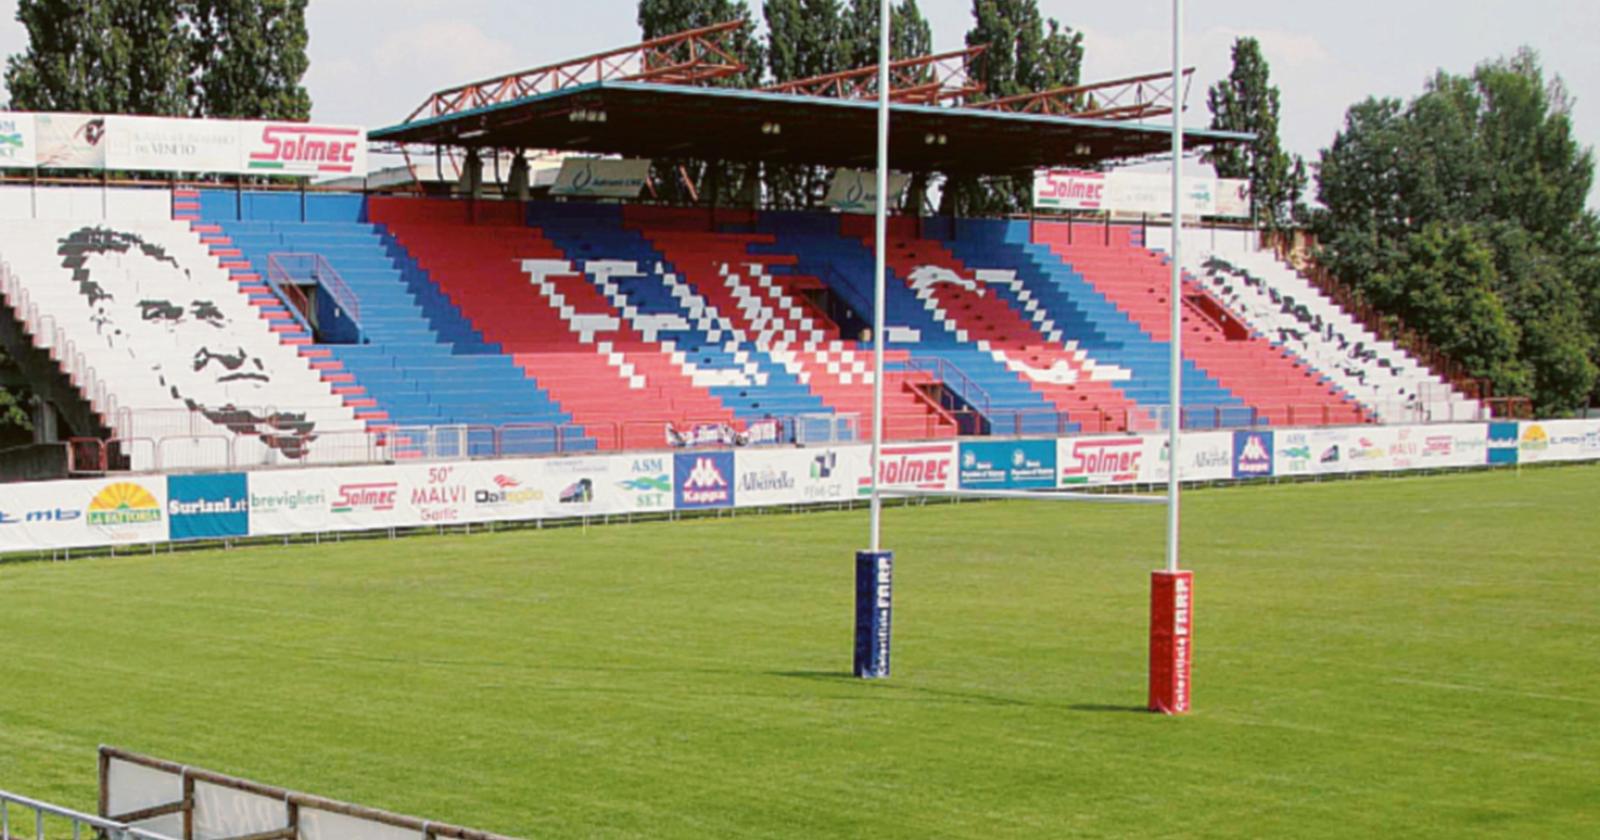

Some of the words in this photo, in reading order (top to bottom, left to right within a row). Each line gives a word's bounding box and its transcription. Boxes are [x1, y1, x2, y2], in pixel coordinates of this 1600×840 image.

[249, 125, 360, 163] Solmec
[1038, 171, 1105, 200] Solmec
[631, 458, 663, 473] ASM
[1063, 438, 1143, 475] Solmec
[251, 489, 325, 510] breviglieri
[331, 482, 398, 508] Solmec
[411, 487, 466, 505] MALVI
[636, 493, 663, 507] SET
[682, 491, 728, 503] Kappa
[877, 557, 891, 608] FARP
[1175, 578, 1188, 634] FARP
